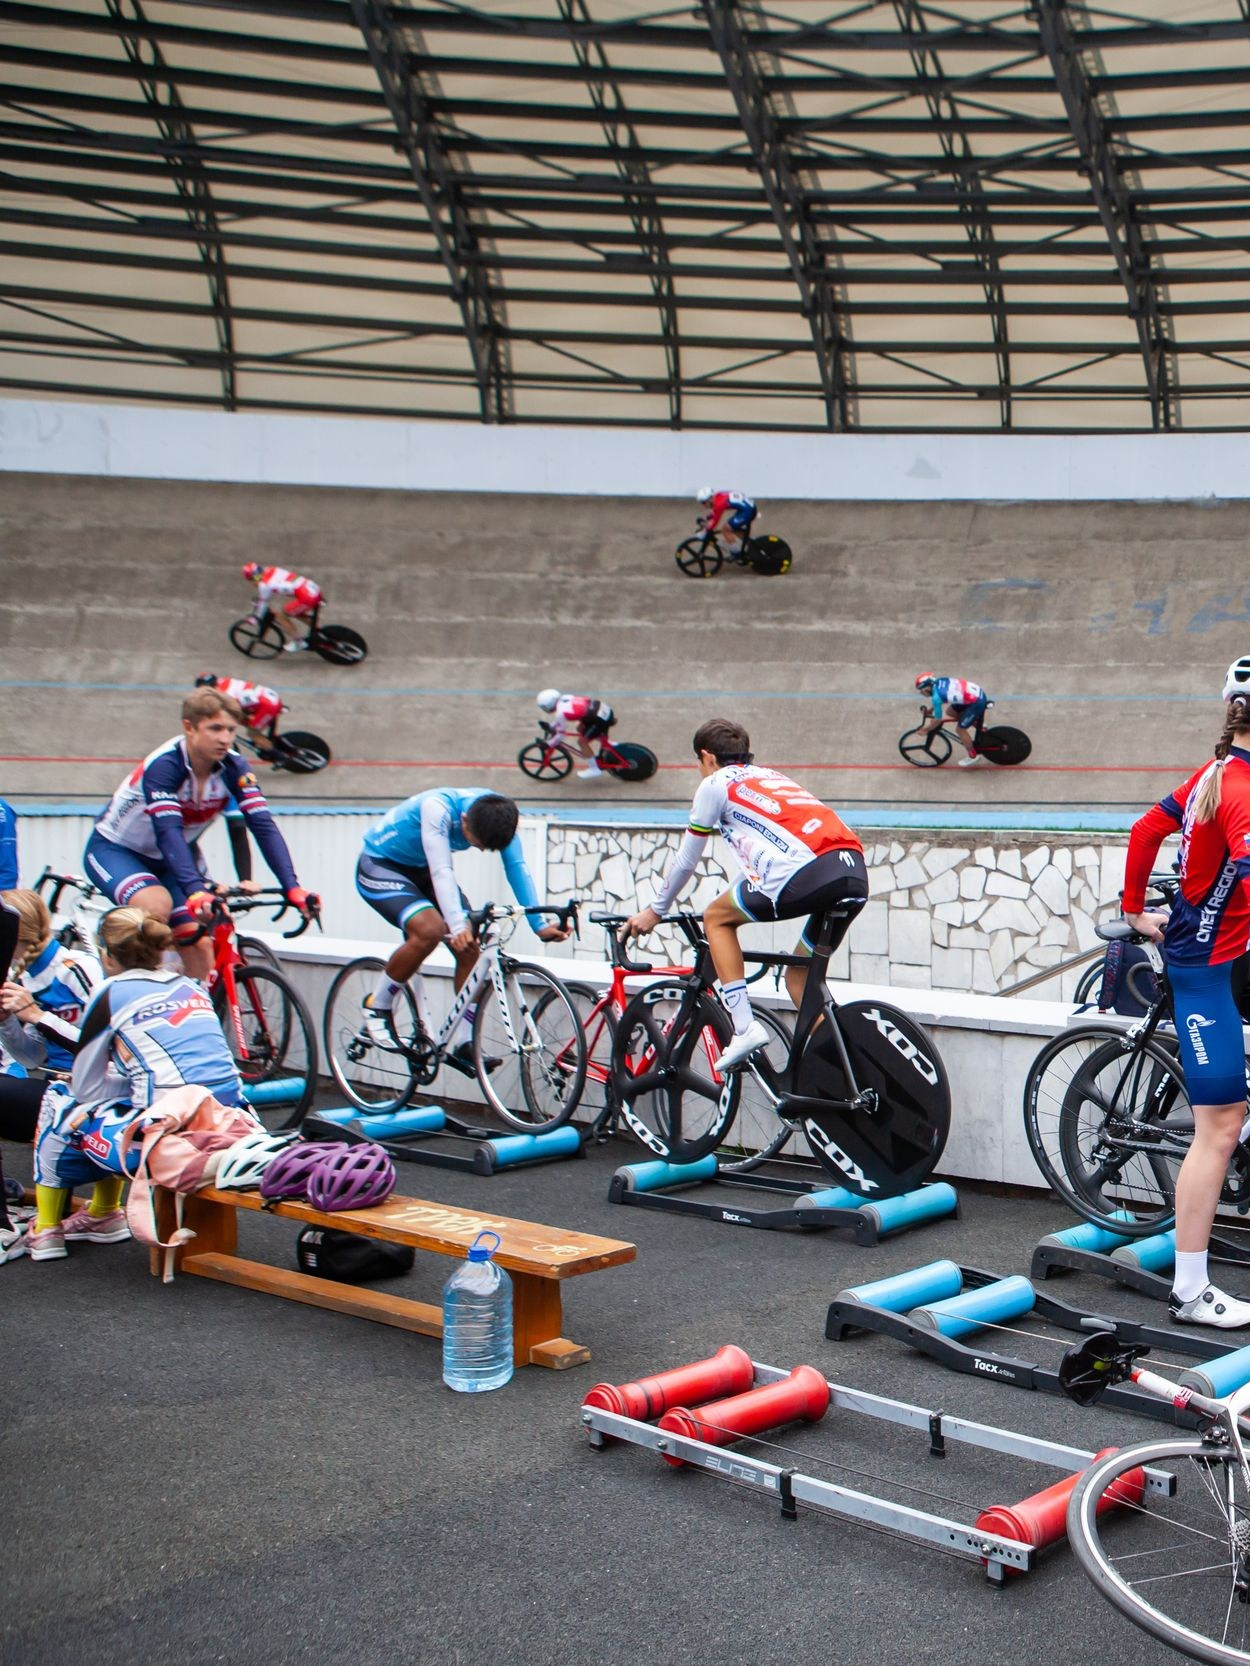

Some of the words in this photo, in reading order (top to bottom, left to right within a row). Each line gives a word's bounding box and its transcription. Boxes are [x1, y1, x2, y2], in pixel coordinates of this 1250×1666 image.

[138, 998, 213, 1020] ROSVEL
[722, 1210, 740, 1221] Tacx
[974, 1358, 998, 1374] Tacx
[705, 1455, 757, 1483] ELITE
